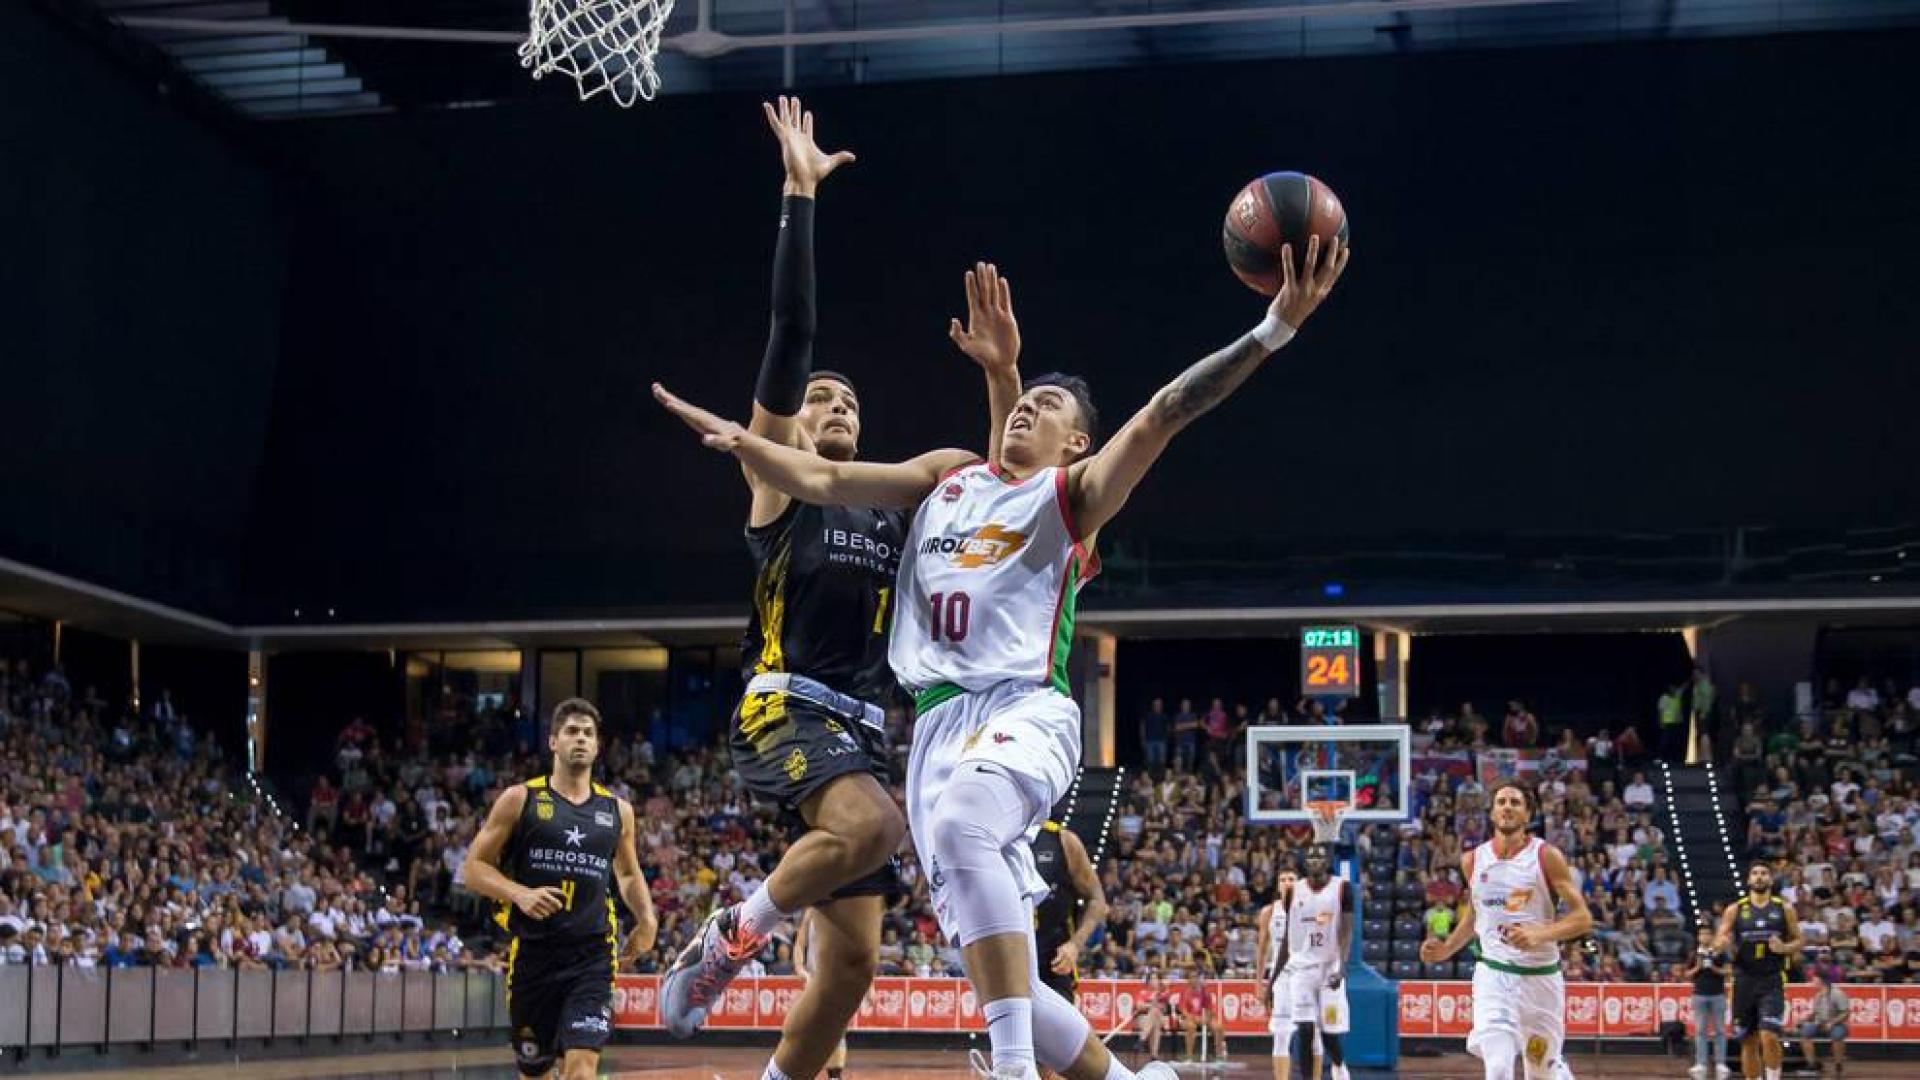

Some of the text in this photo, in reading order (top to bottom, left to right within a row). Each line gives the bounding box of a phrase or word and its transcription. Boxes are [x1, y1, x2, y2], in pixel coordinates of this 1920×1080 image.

[930, 592, 970, 642] 10
[1304, 631, 1352, 646] 07:13
[1308, 655, 1348, 685] 24
[529, 848, 607, 868] IBEROSTAR
[1309, 932, 1324, 947] 12
